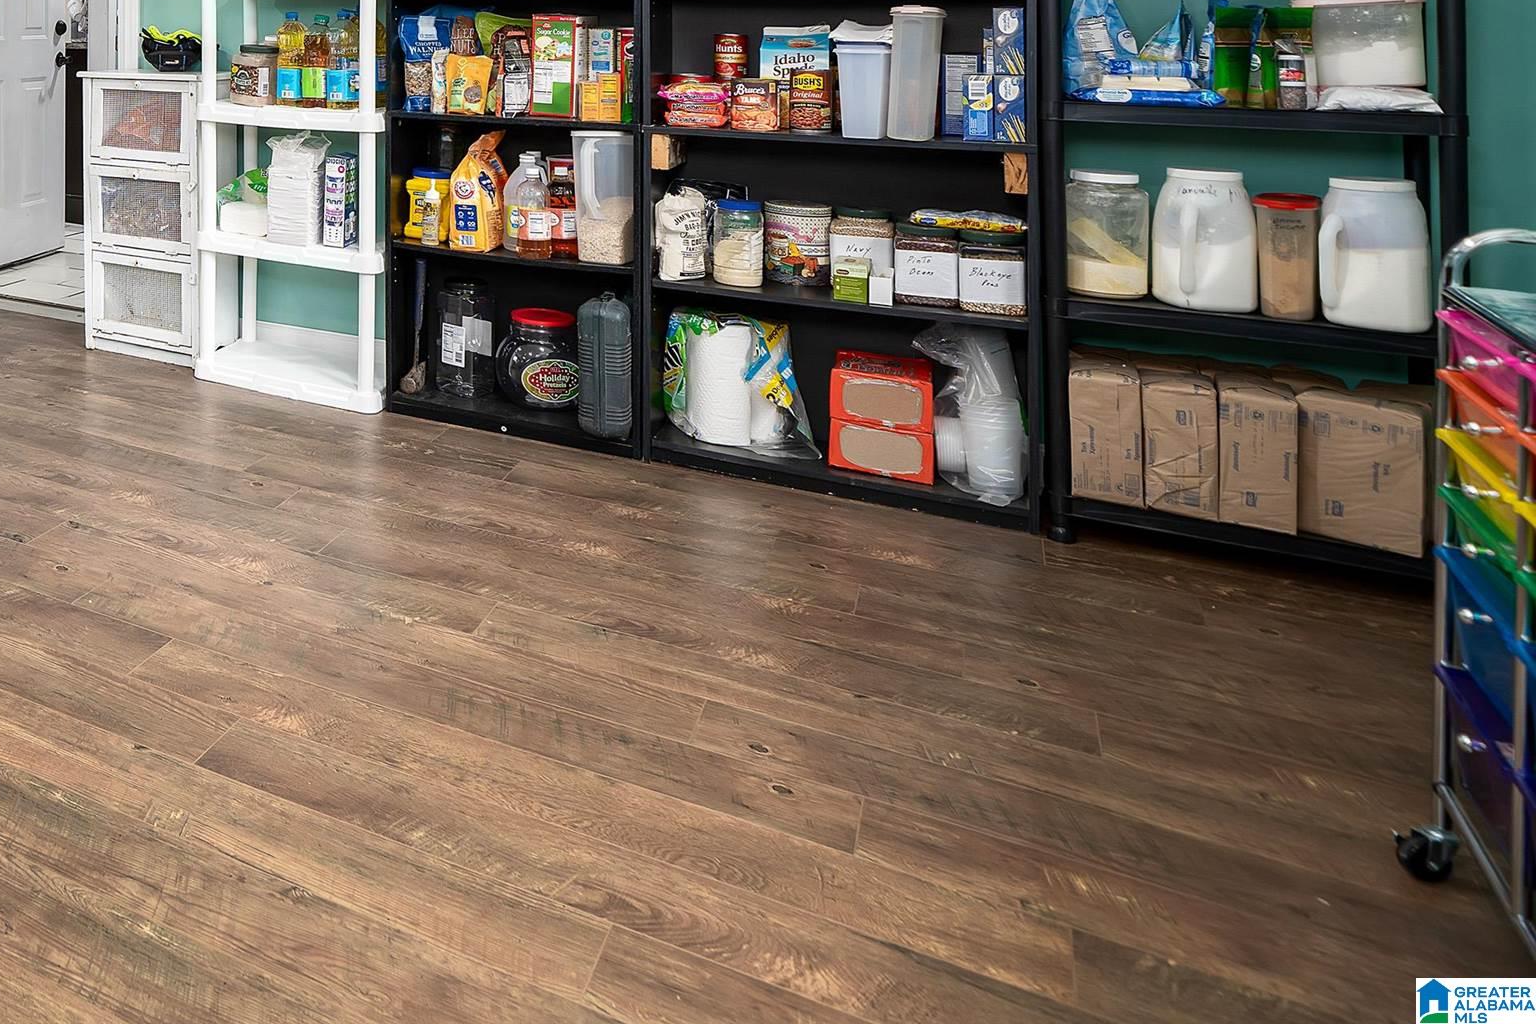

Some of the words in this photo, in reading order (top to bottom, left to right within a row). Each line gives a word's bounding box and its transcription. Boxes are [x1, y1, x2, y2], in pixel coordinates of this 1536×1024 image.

[536, 28, 551, 37] Sugar
[552, 28, 571, 36] Cookie
[715, 44, 742, 53] Hunt's
[774, 53, 815, 65] Idaho
[792, 76, 823, 87] BUSH'S
[735, 84, 765, 96] Bruce's
[792, 91, 823, 99] Original
[845, 244, 871, 256] Navy
[539, 372, 570, 384] Holiday
